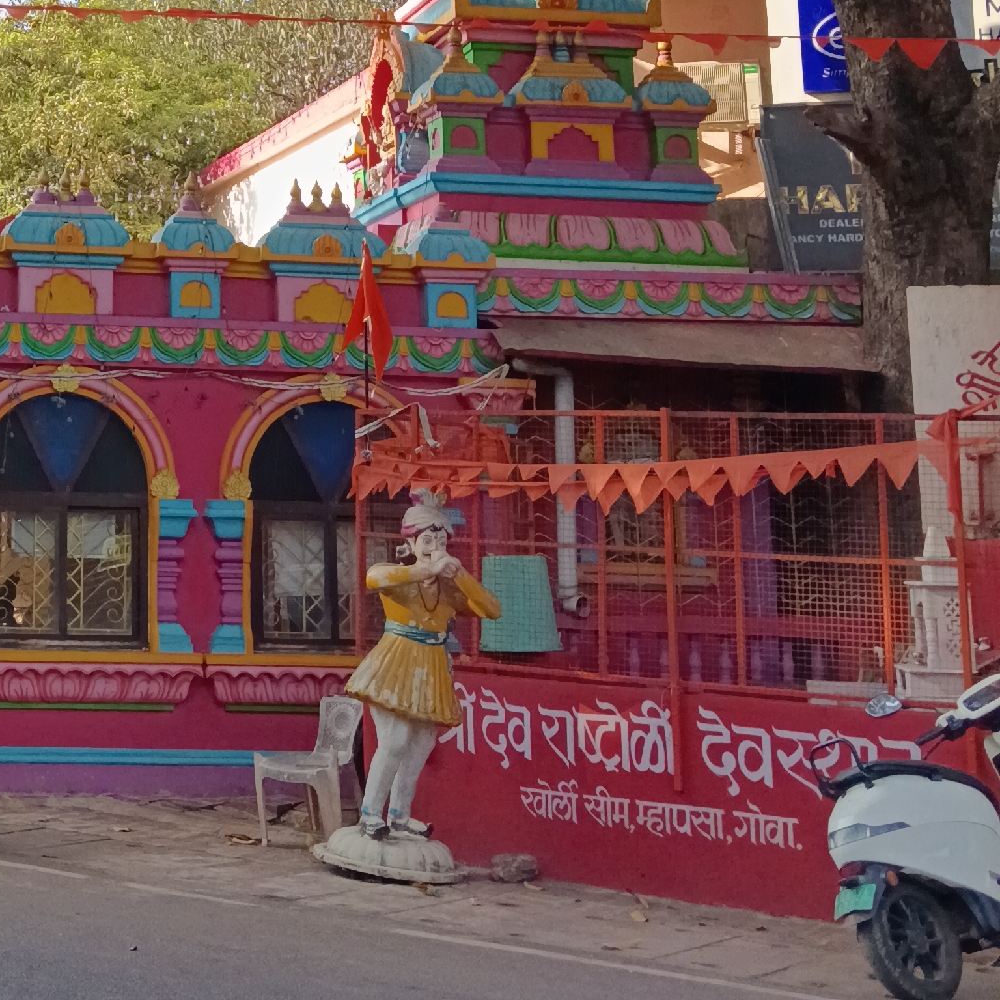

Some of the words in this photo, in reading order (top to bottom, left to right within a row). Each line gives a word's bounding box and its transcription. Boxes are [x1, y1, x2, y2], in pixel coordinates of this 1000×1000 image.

[979, 28, 1000, 40] H
[819, 218, 864, 228] DEALE
[480, 686, 532, 769] देव
